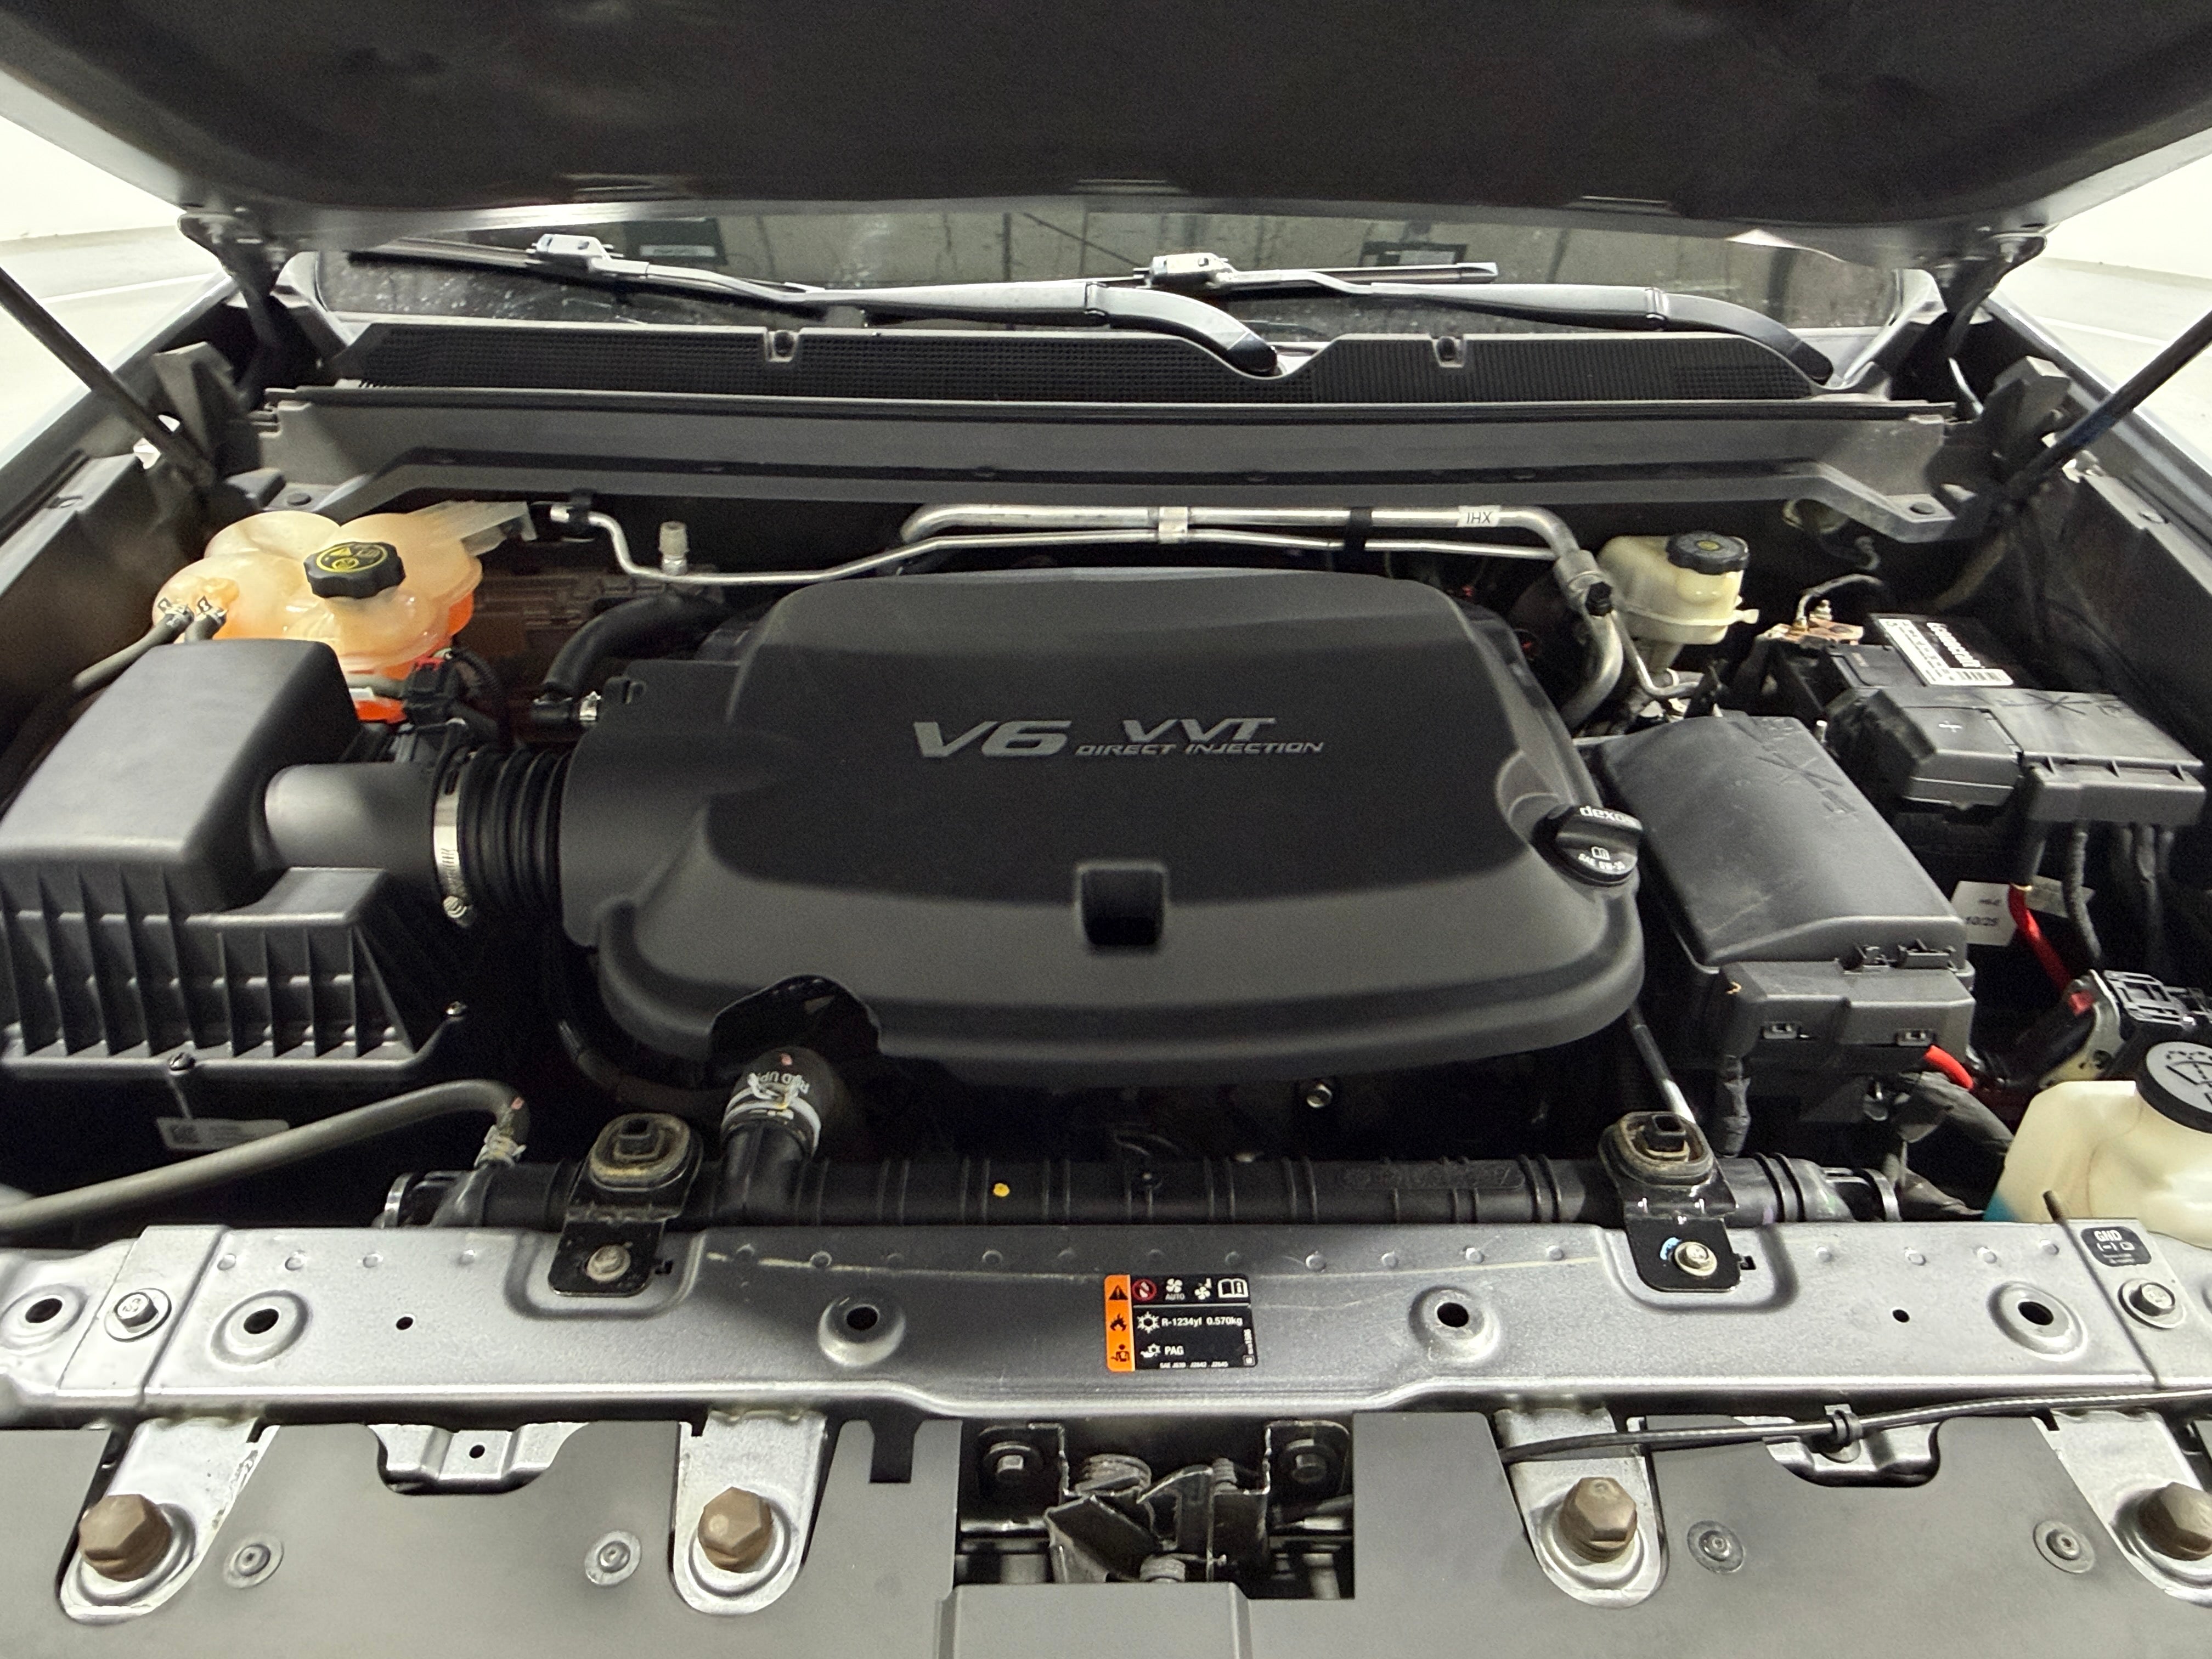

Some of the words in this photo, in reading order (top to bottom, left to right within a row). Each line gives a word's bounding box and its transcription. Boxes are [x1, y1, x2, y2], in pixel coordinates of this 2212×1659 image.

[1466, 512, 1492, 524] IHX
[1122, 717, 1277, 743] VVT
[913, 720, 1071, 758] V6
[1075, 743, 1177, 756] DIRECT
[1185, 741, 1324, 755] INJECTION
[2094, 1230, 2123, 1242] GND
[1206, 1317, 1243, 1327] 0.570kg
[1165, 1346, 1184, 1356] PAG
